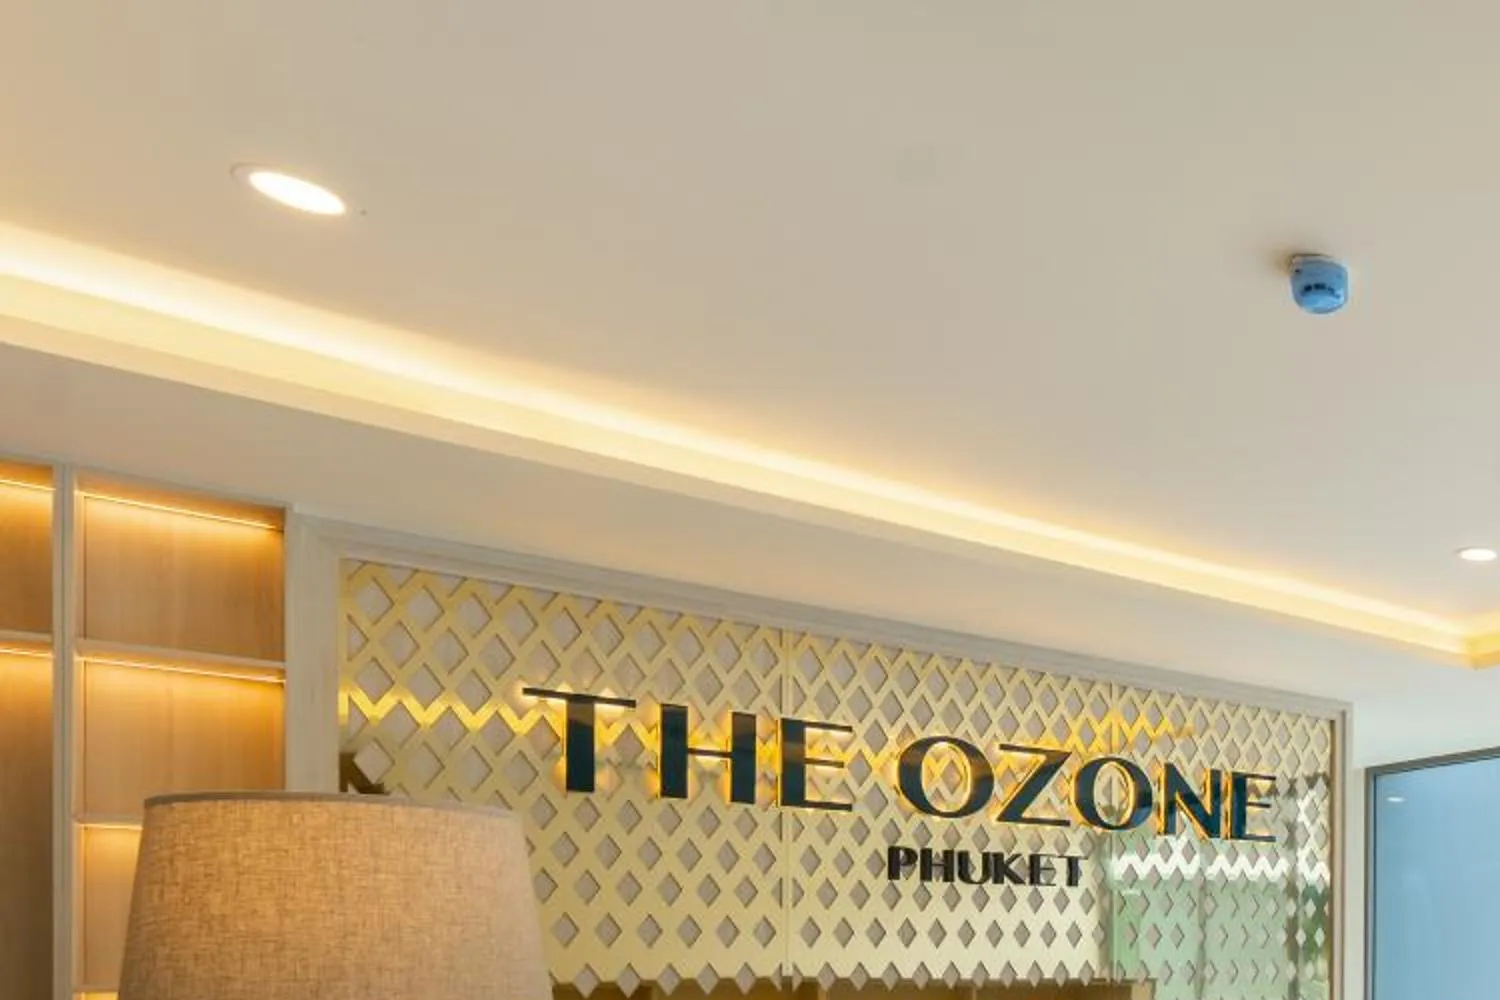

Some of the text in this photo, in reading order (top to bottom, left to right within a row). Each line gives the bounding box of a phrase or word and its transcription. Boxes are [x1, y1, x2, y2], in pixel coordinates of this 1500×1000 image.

[522, 687, 1277, 842] THE OZONE
[887, 846, 1090, 888] PHUKET
